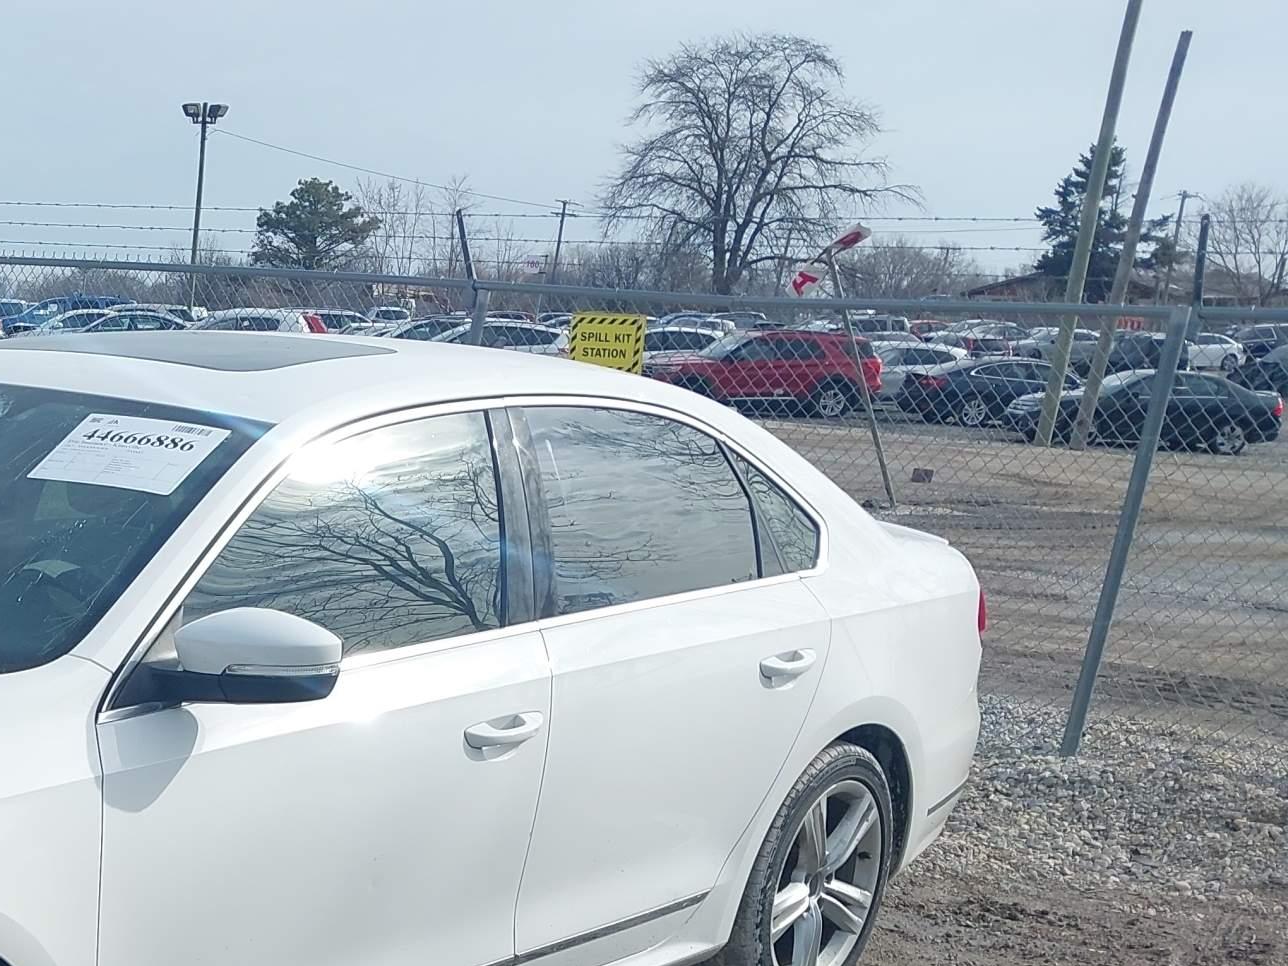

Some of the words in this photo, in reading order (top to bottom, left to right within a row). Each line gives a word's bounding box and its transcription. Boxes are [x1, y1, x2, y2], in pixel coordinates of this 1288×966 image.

[580, 331, 610, 343] SPILL
[614, 333, 632, 344] KIT
[582, 347, 627, 359] STATION
[82, 428, 200, 452] 44666886
